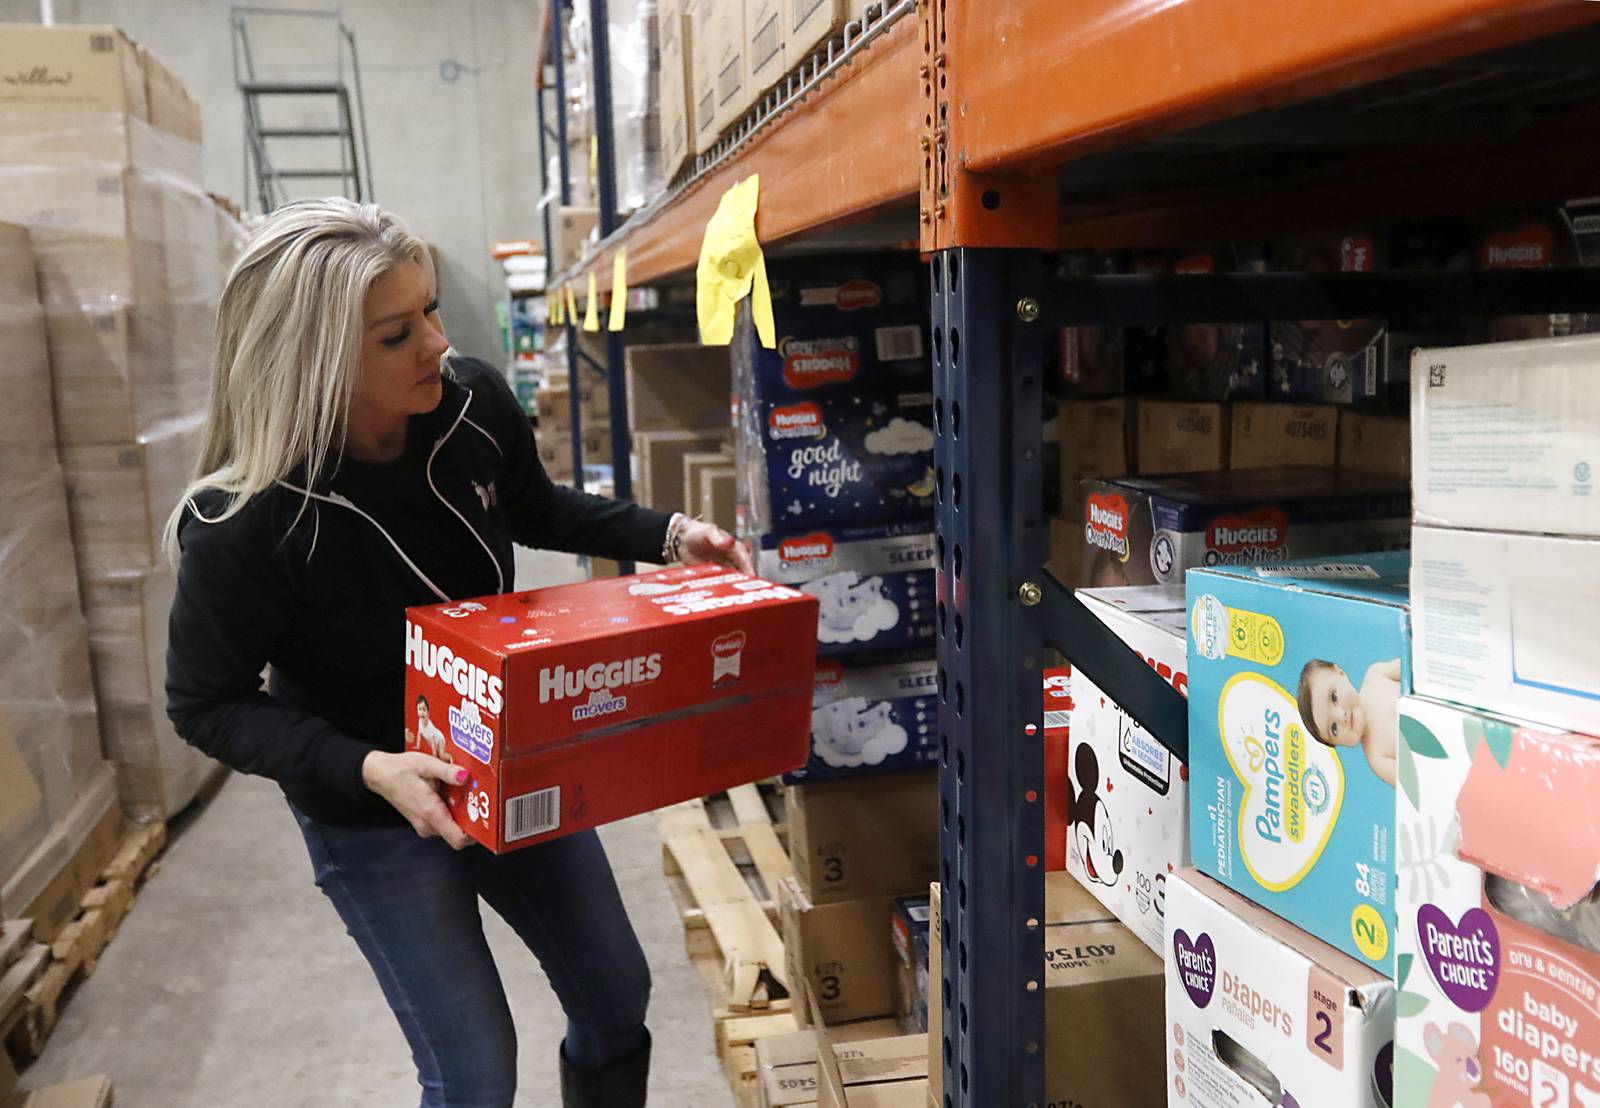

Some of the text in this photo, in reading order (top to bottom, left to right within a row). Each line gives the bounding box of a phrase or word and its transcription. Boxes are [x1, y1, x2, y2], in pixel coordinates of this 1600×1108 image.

[788, 438, 841, 479] good
[808, 459, 863, 498] night
[1090, 502, 1123, 531] HUGGIES
[1214, 527, 1279, 546] HUGGIES
[1205, 595, 1214, 658] SOFTEST
[405, 619, 504, 715] HUGGIES
[539, 652, 662, 704] HUGGIES
[450, 708, 493, 746] movers
[574, 698, 625, 719] movers
[1255, 708, 1286, 844] Pampers
[1289, 729, 1300, 839] swaddlers
[478, 791, 490, 819] 3
[1216, 775, 1227, 877] PEDIATRICIAN
[824, 857, 845, 882] 3
[1135, 870, 1152, 895] 100
[1355, 861, 1370, 897] 84
[1355, 917, 1376, 945] 2
[1427, 922, 1494, 968] Parent's
[1178, 942, 1214, 976] Parent's
[1440, 961, 1489, 991] CHOICE
[821, 975, 841, 1000] 3
[1184, 970, 1210, 993] CHOICE
[1313, 988, 1338, 1012] stage
[1221, 970, 1295, 1038] Diapers
[1523, 991, 1580, 1039] baby
[1314, 1010, 1334, 1055] 2
[1497, 1007, 1600, 1082] diapers
[1493, 1044, 1530, 1082] 160
